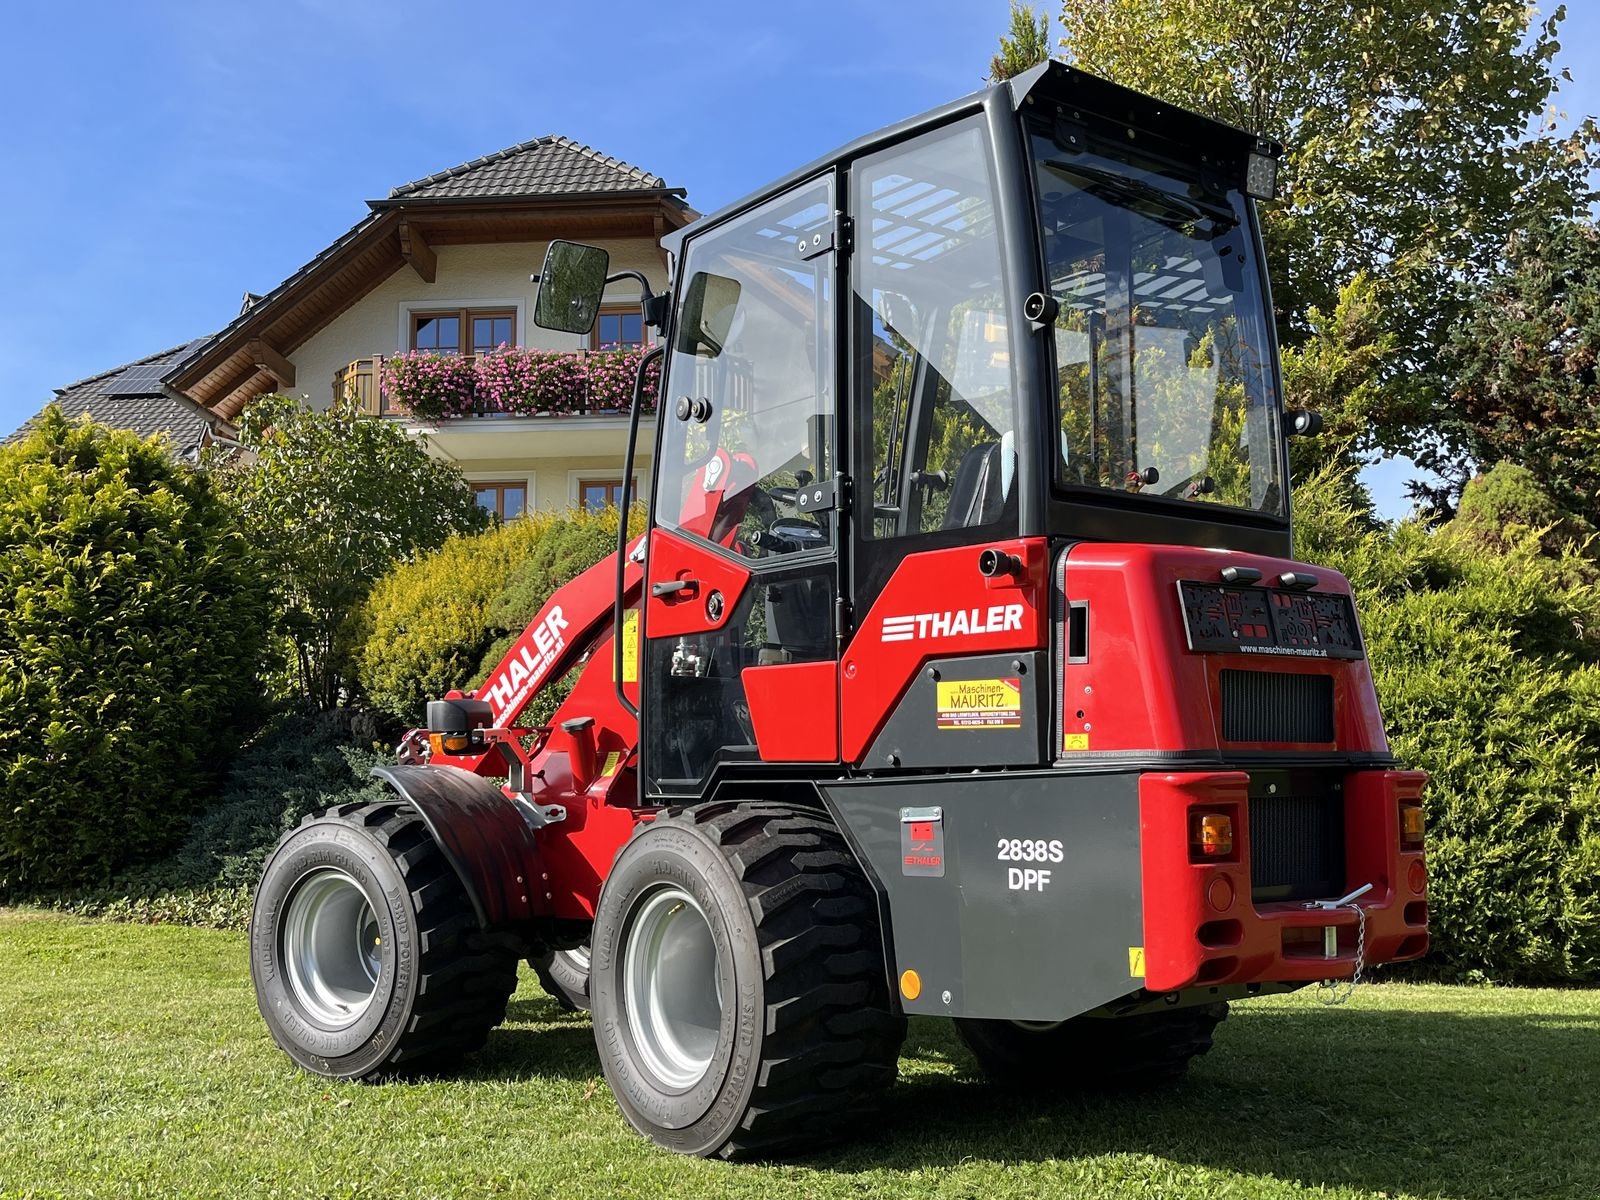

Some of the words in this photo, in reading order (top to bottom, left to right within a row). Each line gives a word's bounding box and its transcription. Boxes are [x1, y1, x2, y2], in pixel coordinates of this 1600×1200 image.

[915, 604, 1024, 639] THALER
[1239, 645, 1328, 657] www.maschinen-mauritz.at
[492, 637, 566, 729] aschinen-mauritz.at
[959, 684, 1004, 695] Maschinen-
[950, 694, 1004, 708] MAURITZ
[912, 856, 941, 865] THALER
[997, 838, 1064, 863] 2838S
[1008, 867, 1052, 892] DPF
[392, 901, 408, 935] SKID
[398, 940, 411, 990] POWER
[742, 1003, 755, 1047] SKID
[721, 1053, 749, 1109] POWER
